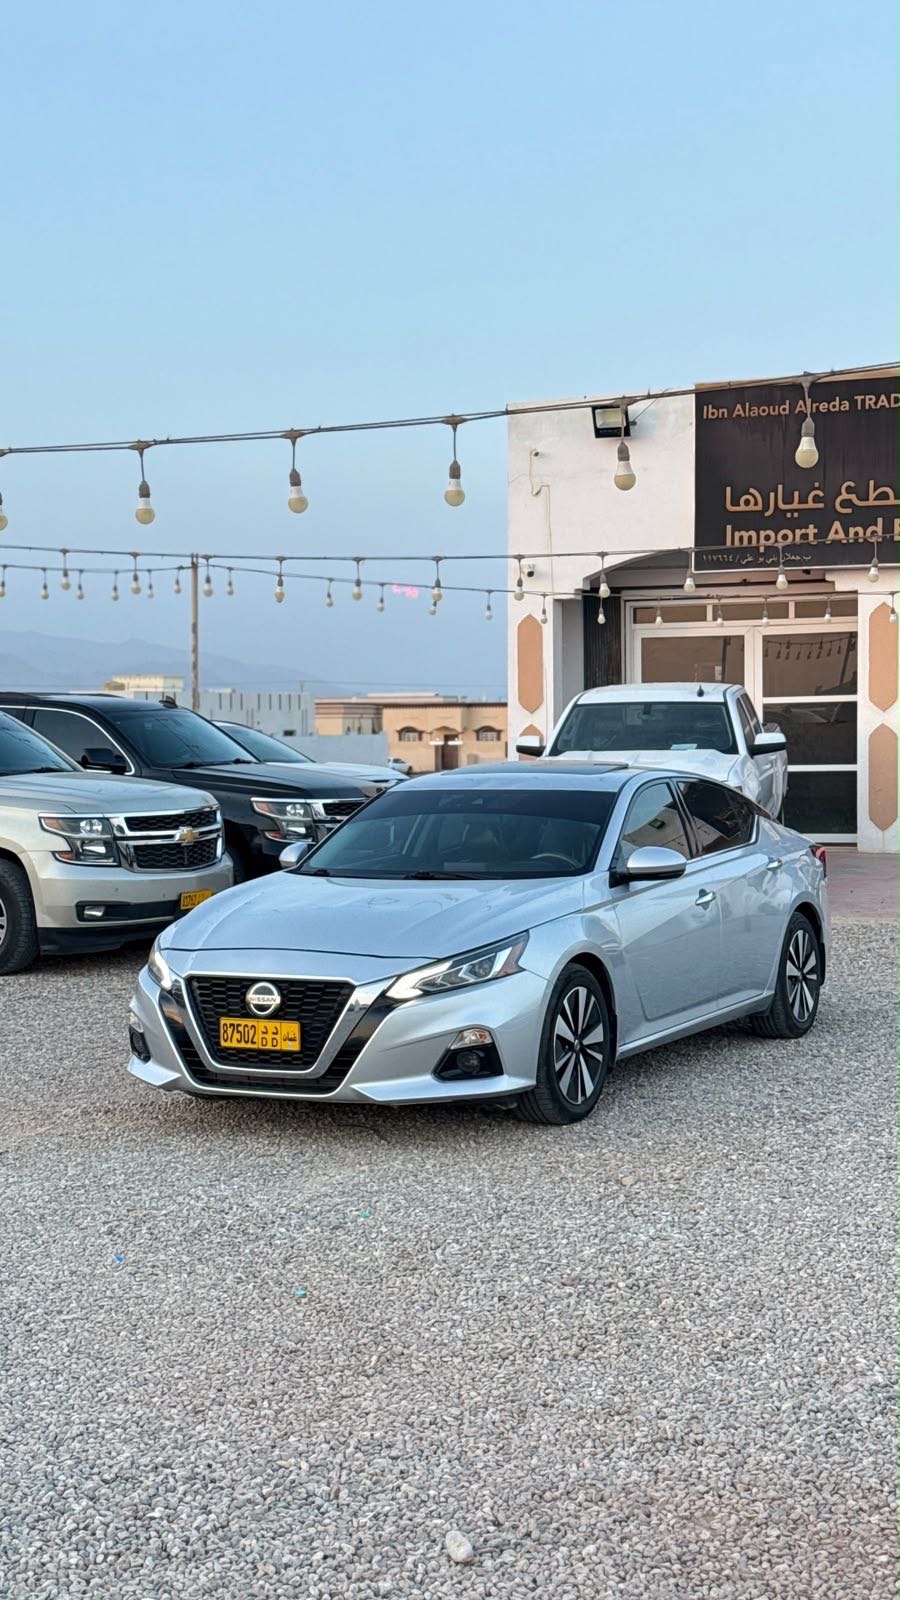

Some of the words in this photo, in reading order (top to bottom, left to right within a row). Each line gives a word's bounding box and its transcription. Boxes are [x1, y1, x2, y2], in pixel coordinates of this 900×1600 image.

[703, 404, 728, 420] Ibn
[732, 399, 790, 418] Alaoud
[794, 396, 850, 414] Alreda
[725, 481, 825, 518] غيارها
[725, 524, 819, 553] Import
[824, 517, 883, 544] And
[222, 1023, 257, 1045] 87502
